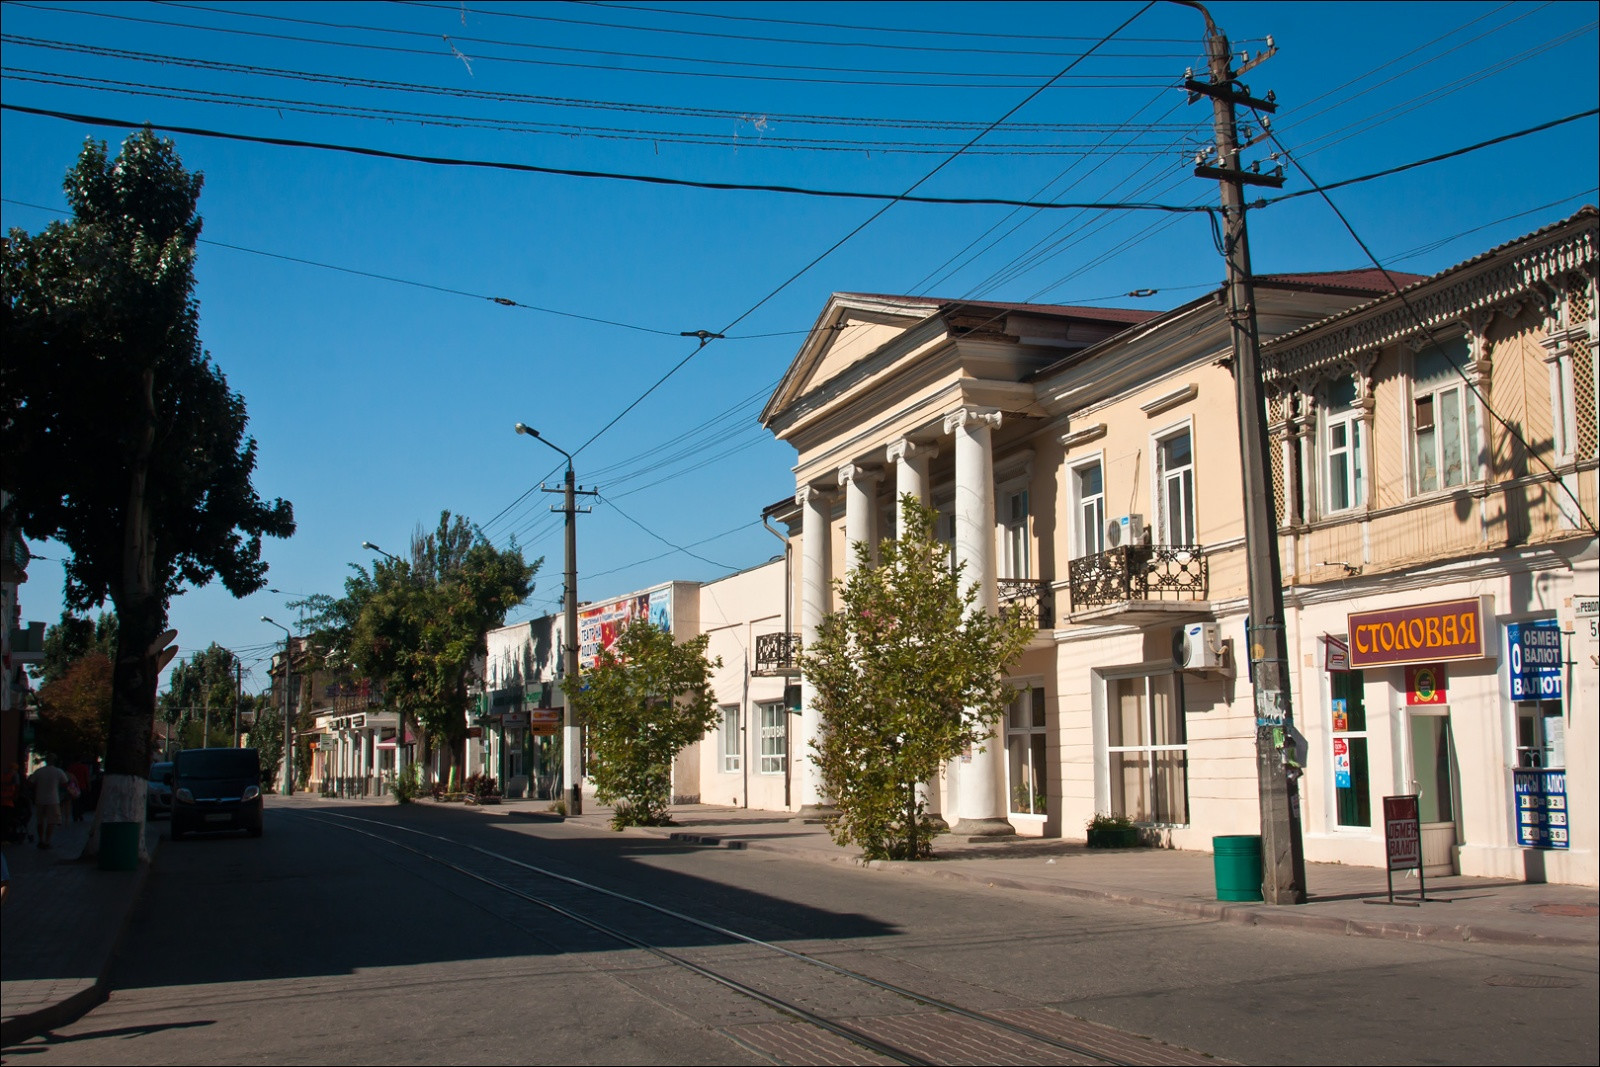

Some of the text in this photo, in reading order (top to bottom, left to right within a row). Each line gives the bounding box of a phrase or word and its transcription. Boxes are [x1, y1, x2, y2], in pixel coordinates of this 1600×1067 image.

[1355, 612, 1476, 654] СТОЛОВАЯ
[1523, 630, 1559, 646] ОБМЕН
[1524, 648, 1559, 663] ВАЛЮТ
[1513, 676, 1561, 695] ВАЛЮТ
[1390, 822, 1417, 839] ОБМЕН
[1390, 839, 1417, 856] ВАЛЮТ
